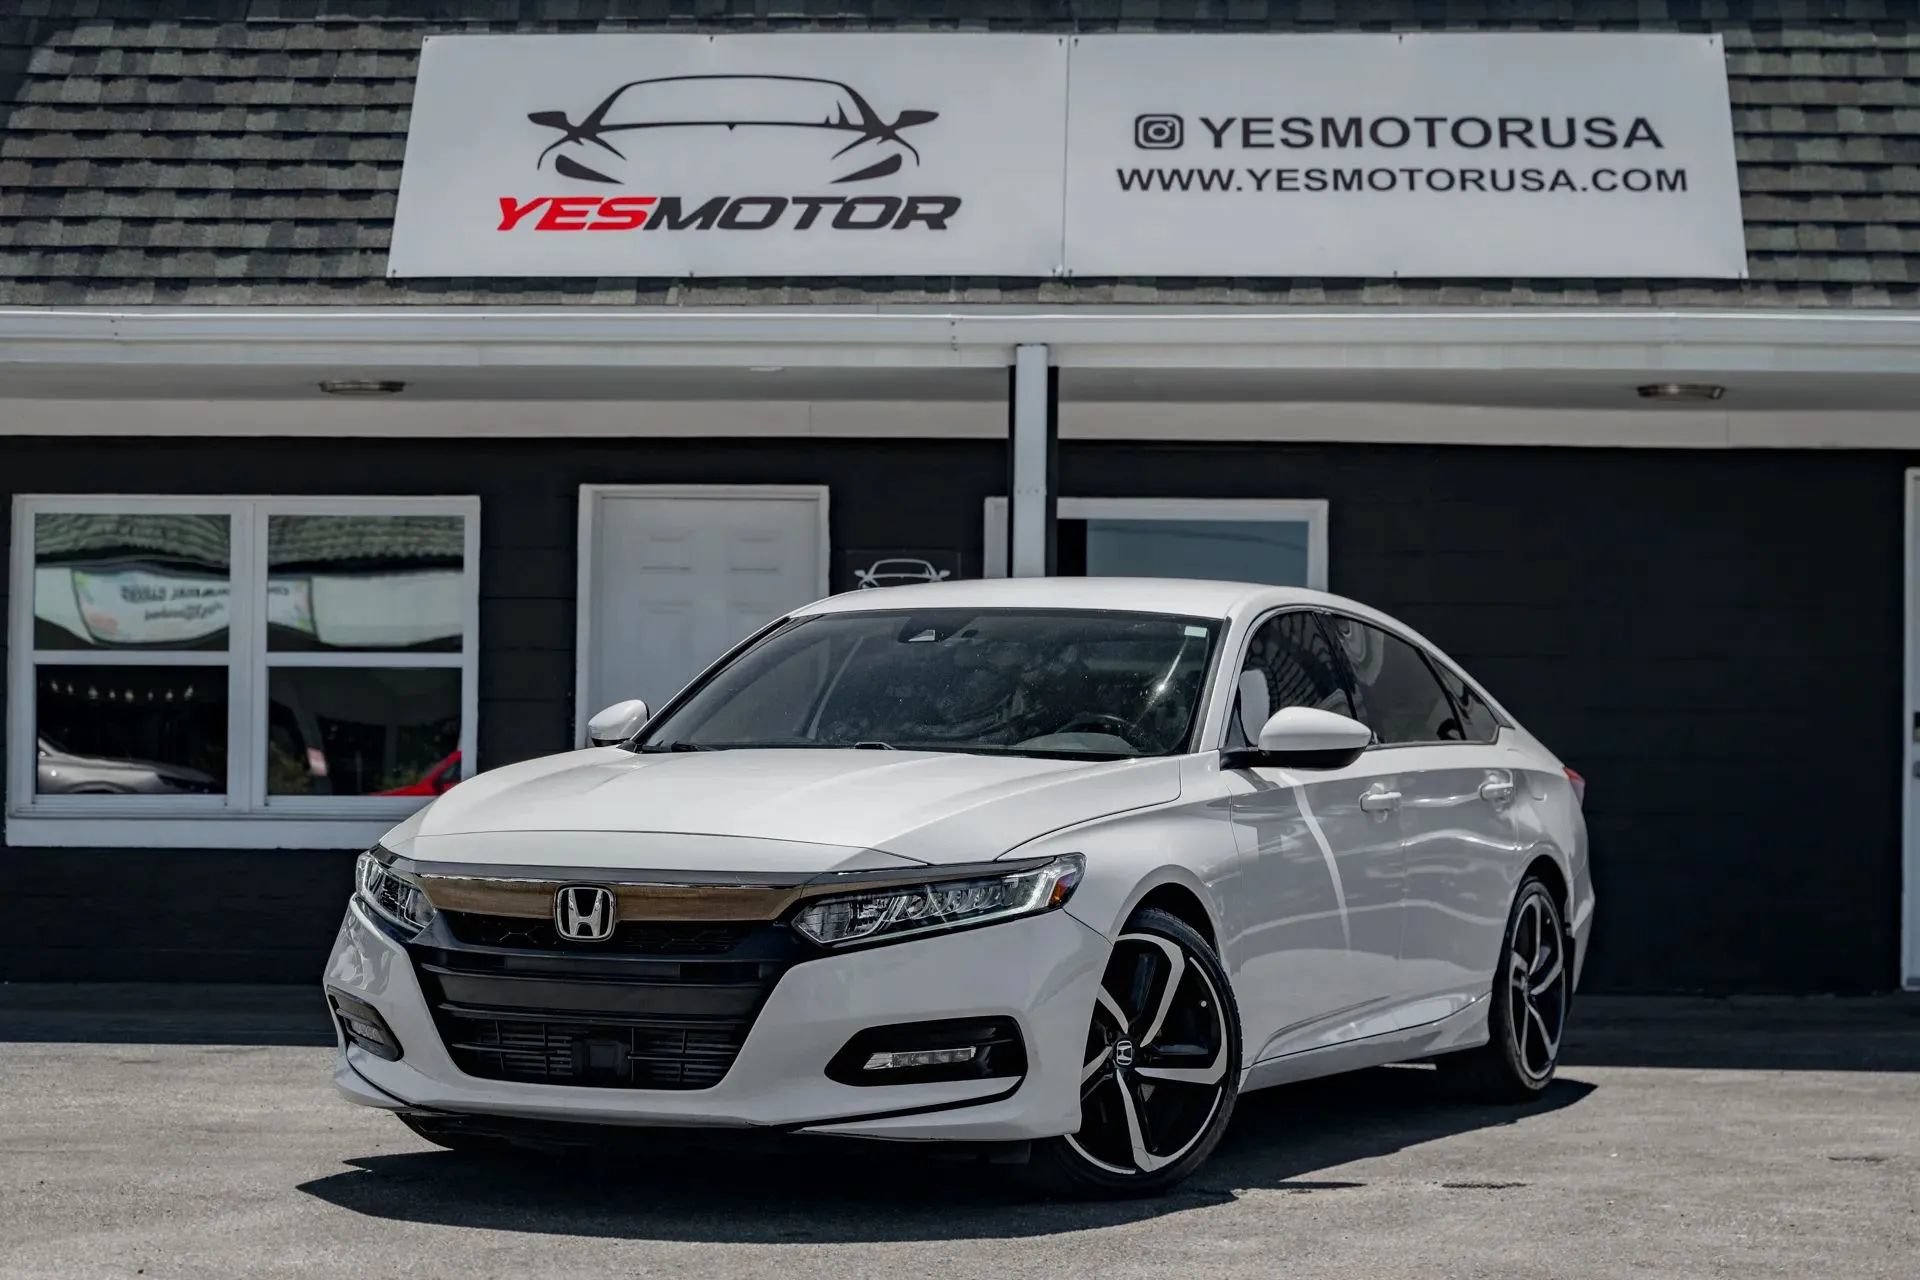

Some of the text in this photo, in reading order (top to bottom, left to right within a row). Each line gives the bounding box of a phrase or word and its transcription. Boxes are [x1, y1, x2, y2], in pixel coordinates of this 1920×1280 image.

[1199, 116, 1665, 150] YESMOTORUSA
[1116, 168, 1688, 193] WWW.YESMOTORUSA.COM
[496, 195, 962, 232] YESMOTOR
